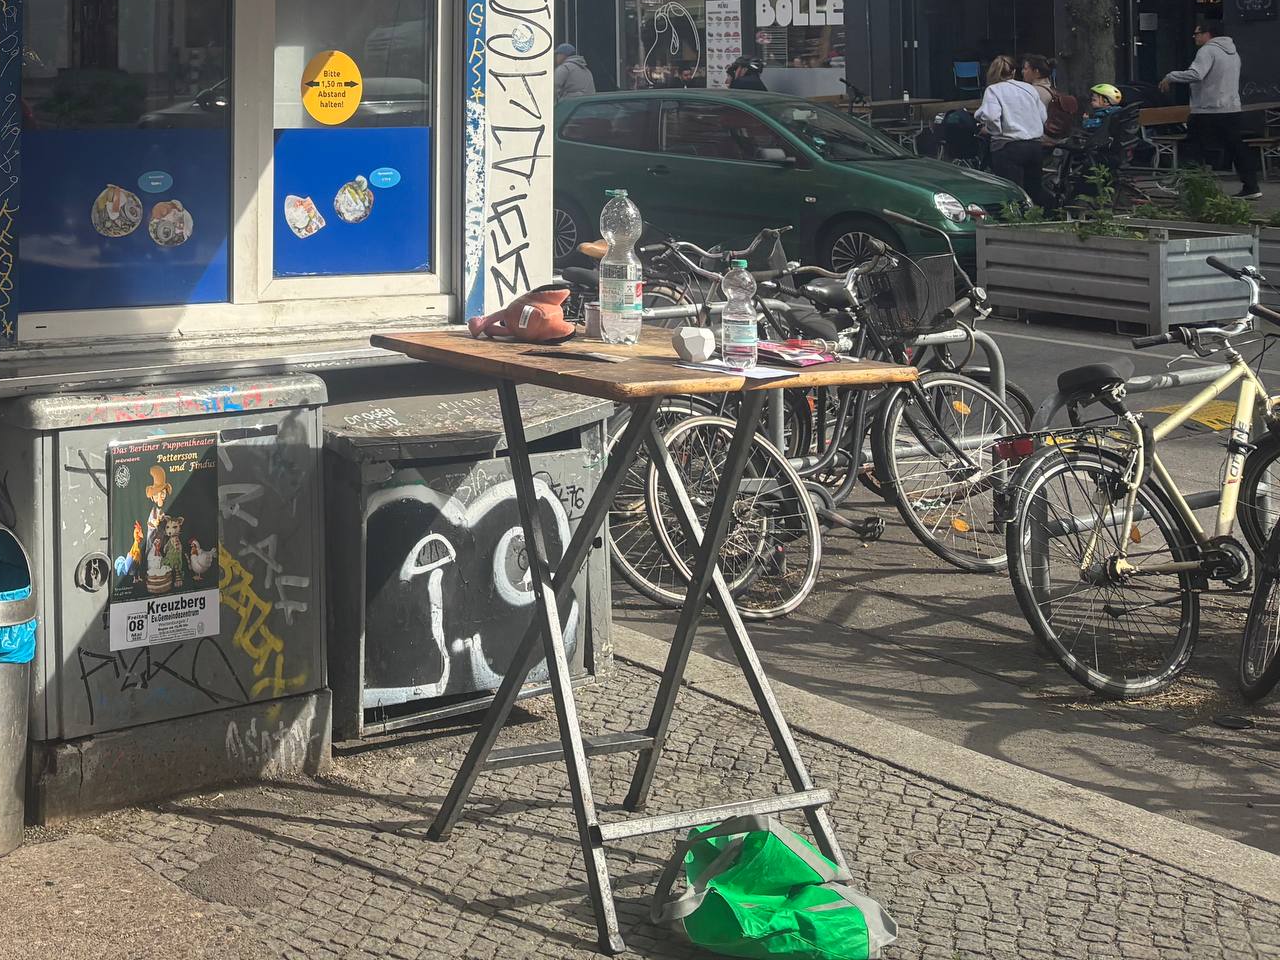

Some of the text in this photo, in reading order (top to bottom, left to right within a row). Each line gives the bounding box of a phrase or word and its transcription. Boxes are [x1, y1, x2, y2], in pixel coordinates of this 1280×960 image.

[111, 438, 214, 454] Das Berliner Puppentheater
[157, 452, 198, 463] Pettersson
[169, 459, 216, 472] und Findus
[147, 595, 206, 615] Kreuzberg
[129, 620, 144, 632] 08
